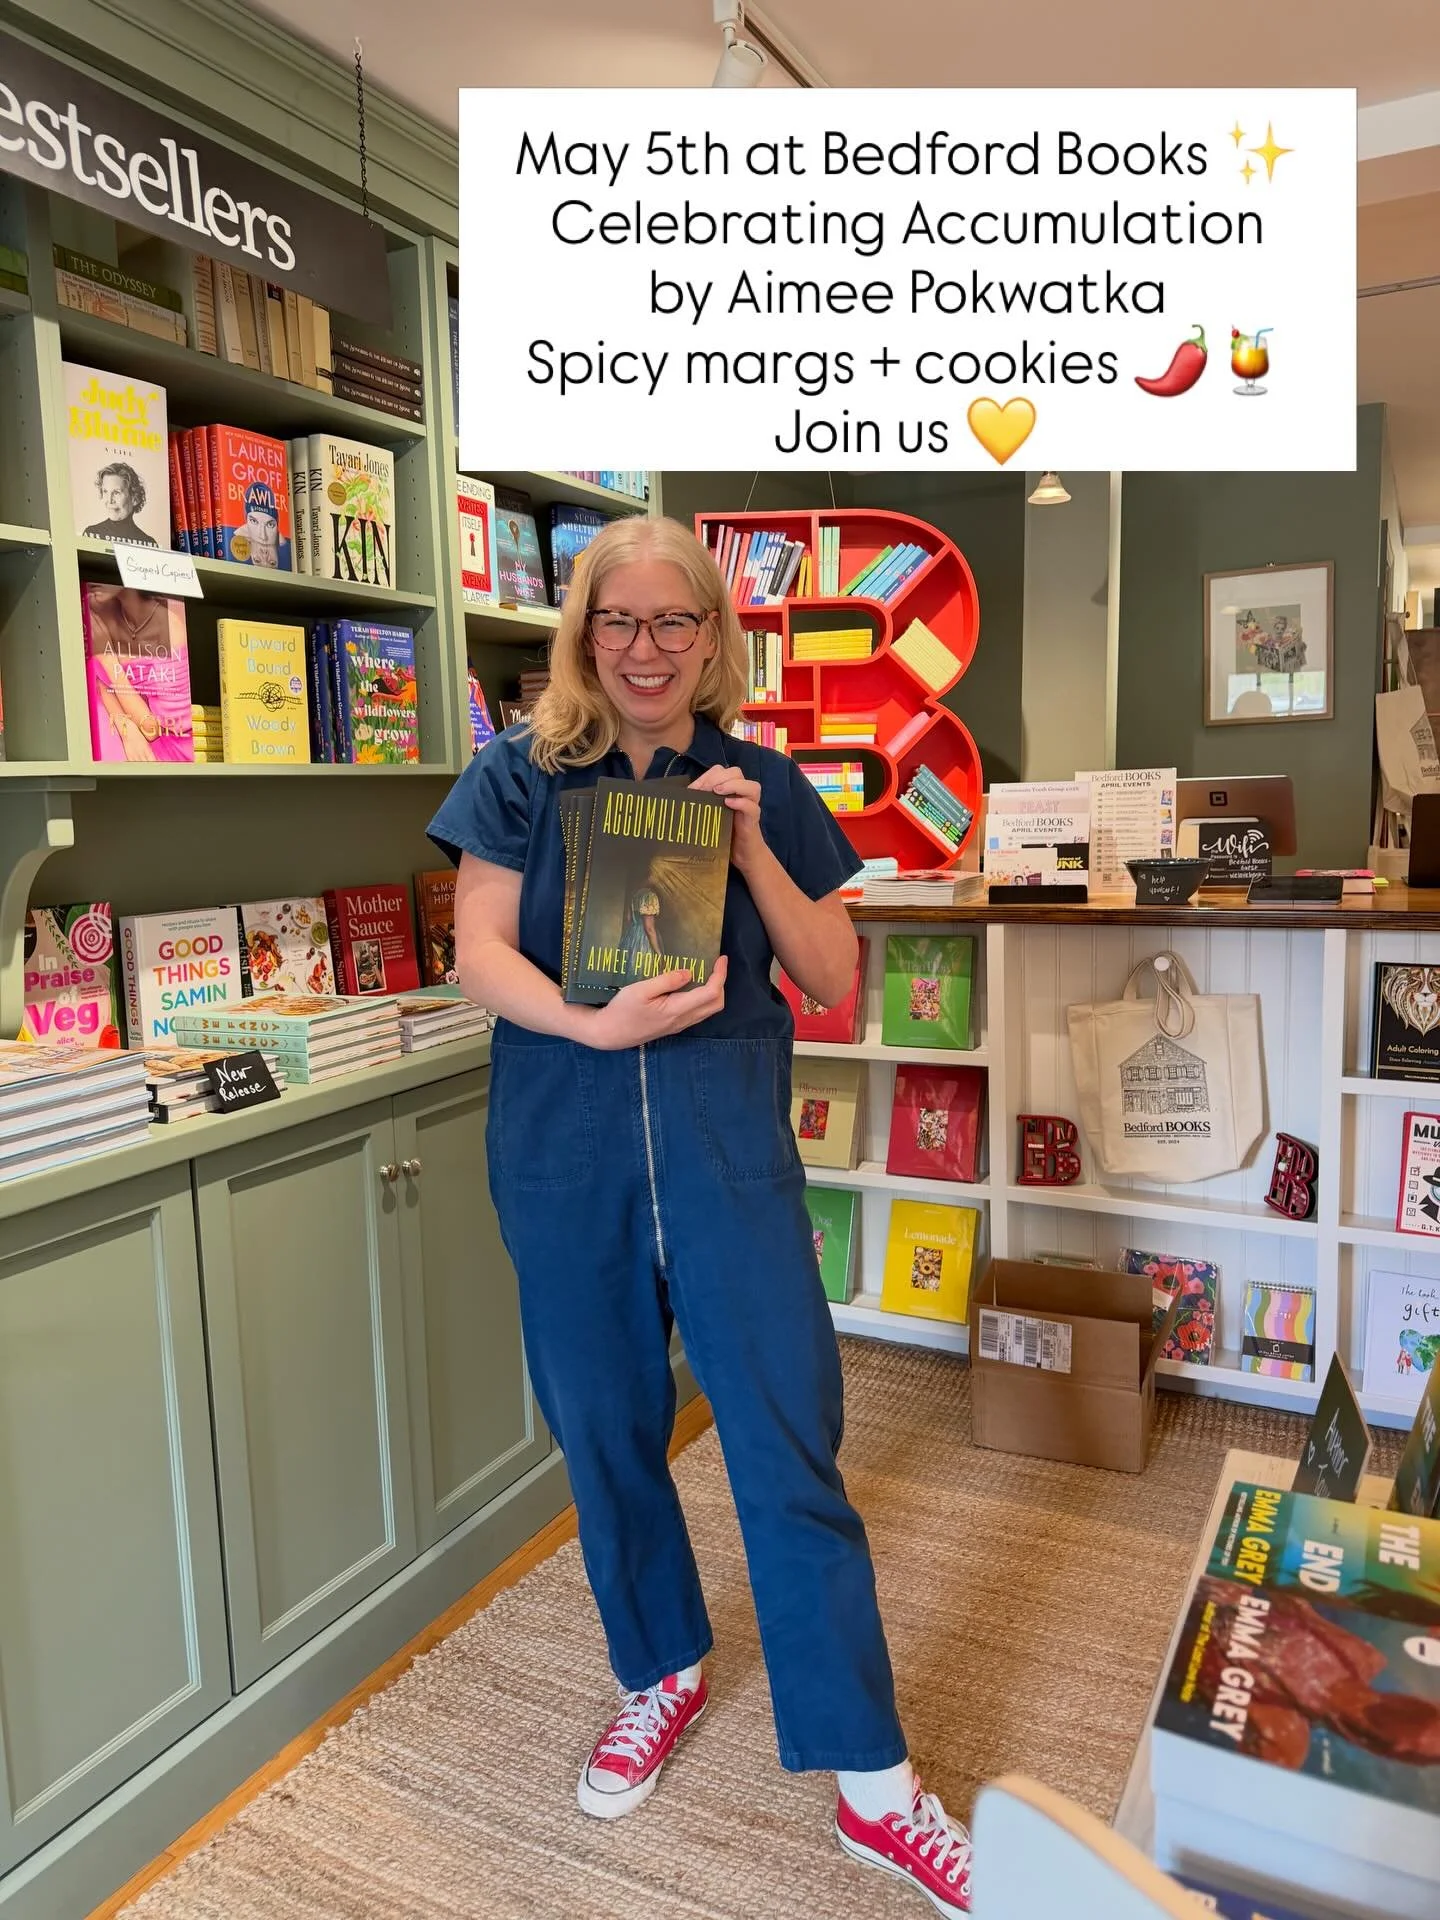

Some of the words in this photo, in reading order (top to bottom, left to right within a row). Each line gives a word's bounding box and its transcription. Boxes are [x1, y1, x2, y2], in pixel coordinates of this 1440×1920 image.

[71, 256, 97, 279] THE
[102, 268, 157, 299] ODYSSEY
[80, 378, 158, 425] Judy
[69, 405, 162, 452] Blume
[228, 439, 283, 468] LAUREN
[328, 444, 361, 472] Tayari
[363, 453, 390, 476] Jones
[232, 462, 282, 490] GROFF
[293, 471, 306, 496] KIN
[309, 468, 323, 492] KIN
[228, 482, 288, 513] BRAWLER
[215, 508, 223, 544] BRAWLER
[329, 512, 391, 587] KIN
[514, 560, 526, 570] MY
[499, 571, 544, 588] HUSBAND'S
[514, 586, 536, 598] WIFE
[103, 640, 182, 662] ALLISON
[239, 631, 296, 654] Upward
[113, 663, 177, 683] PATAKI
[247, 657, 291, 676] Bound
[351, 652, 395, 670] where
[360, 680, 379, 693] the
[246, 715, 297, 731] Woody
[354, 704, 416, 719] wildflowers
[140, 714, 191, 738] GIRL
[374, 728, 411, 746] grow
[251, 740, 296, 757] Brown
[1091, 772, 1124, 782] Bedford
[1125, 771, 1161, 781] BOOKS
[603, 791, 722, 848] ACCUMULATION
[1002, 818, 1034, 828] Bedford
[1036, 817, 1073, 827] BOOKS
[1202, 833, 1270, 858] Wifi
[345, 892, 403, 917] Mother
[348, 918, 394, 938] Sauce
[124, 927, 135, 972] GOOD
[158, 935, 223, 961] GOOD
[587, 946, 629, 974] AIMEE
[38, 954, 58, 972] In
[152, 957, 231, 986] THINGS
[25, 965, 95, 992] Praise
[58, 986, 78, 1004] of
[128, 976, 139, 1026] THINGS
[161, 983, 226, 1011] SAMIN
[26, 1001, 99, 1036] Veg
[1387, 1044, 1407, 1053] Adult
[1408, 1046, 1439, 1056] Coloring
[215, 1059, 252, 1087] New
[219, 1081, 266, 1101] Release
[1124, 1122, 1163, 1132] Bedford
[1166, 1121, 1211, 1132] BOOKS
[904, 1227, 957, 1245] Lemonade
[1247, 1490, 1281, 1533] EMMA
[1378, 1523, 1420, 1571] THE
[1234, 1536, 1271, 1586] GREY
[1299, 1539, 1345, 1593] END
[1226, 1594, 1271, 1659] EMMA
[1209, 1666, 1255, 1742] GREY
